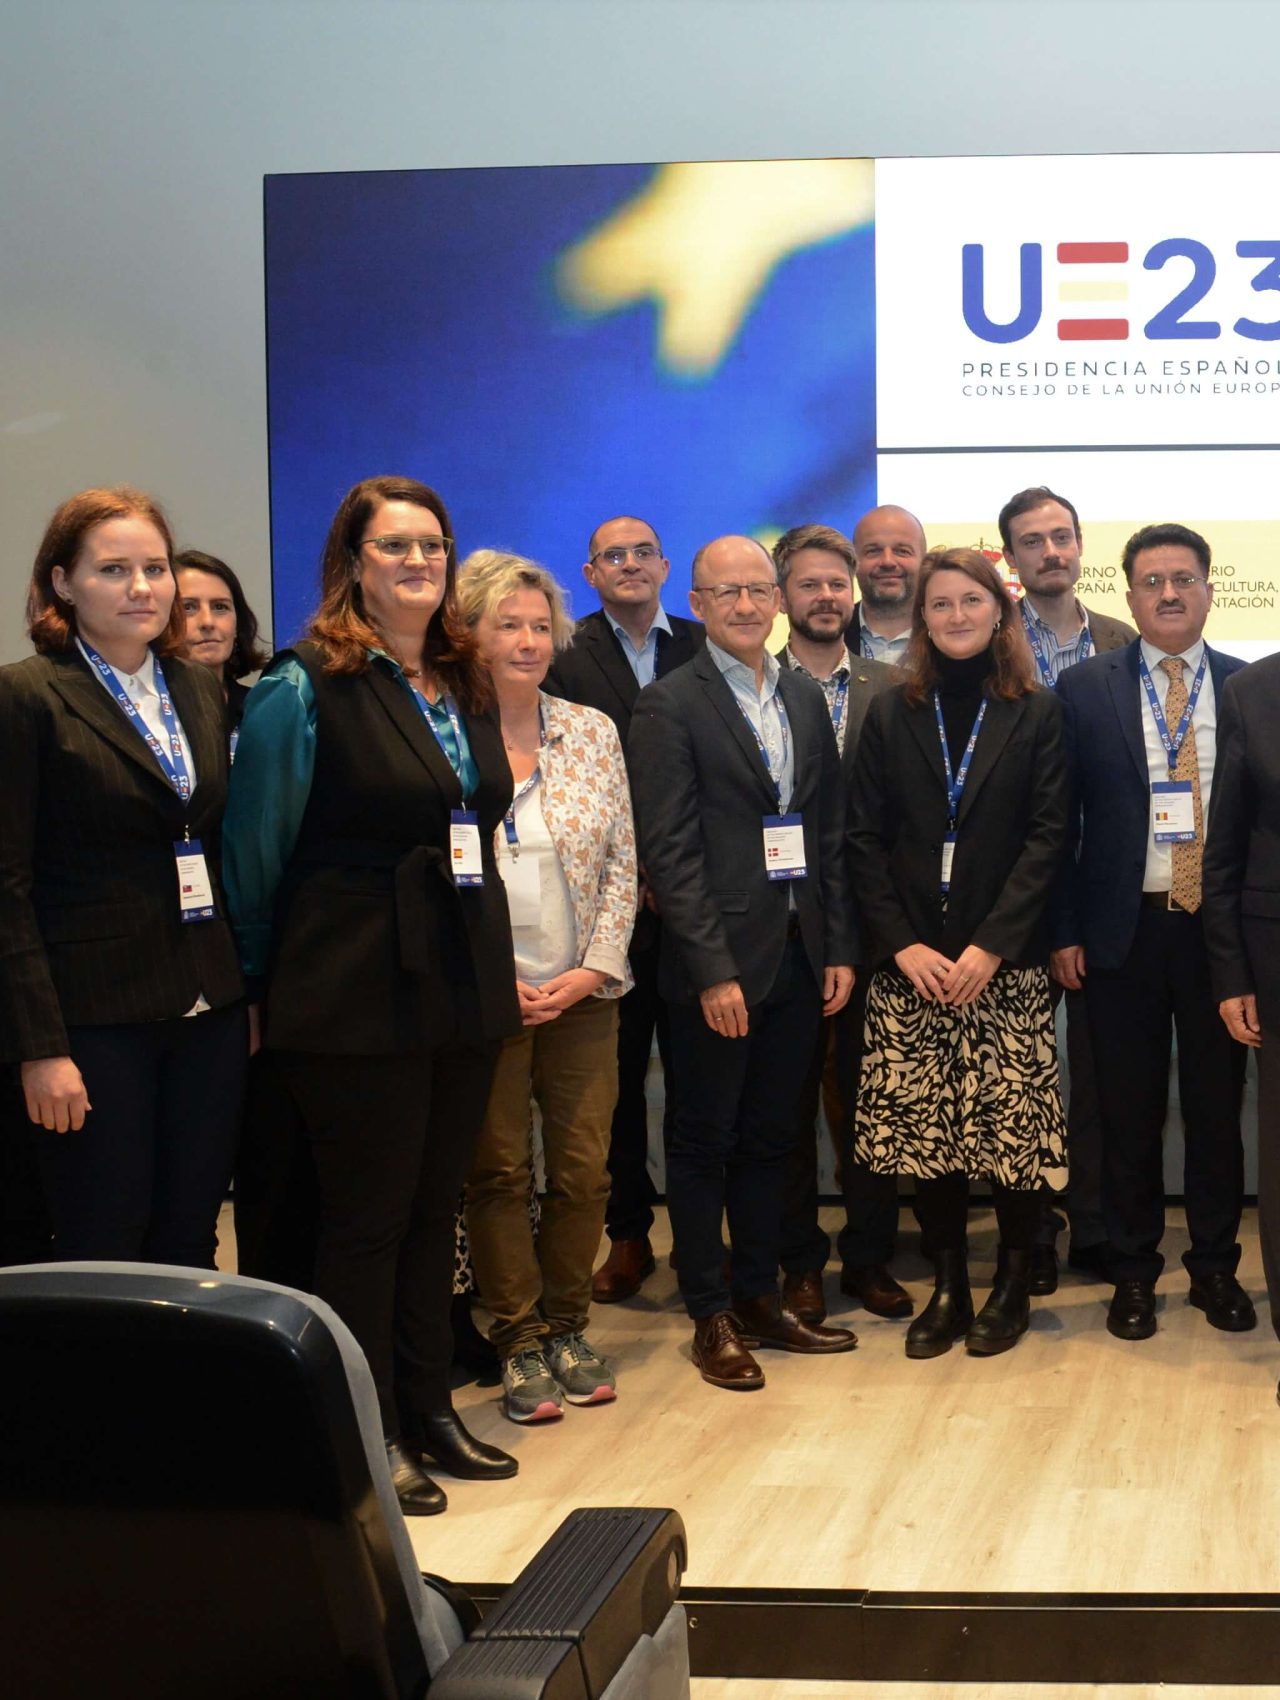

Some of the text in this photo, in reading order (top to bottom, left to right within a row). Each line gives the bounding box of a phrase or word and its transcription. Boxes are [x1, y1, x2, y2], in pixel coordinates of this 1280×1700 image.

[962, 361, 1147, 378] PRESIDENCIA
[962, 384, 1056, 397] CONSEJO
[1067, 384, 1092, 396] DE
[1102, 383, 1125, 395] LA
[1135, 380, 1202, 394] UNIÓN
[1072, 580, 1117, 594] PAÑA
[1213, 581, 1279, 593] CULTURA,
[1212, 594, 1274, 608] NTACIÓN
